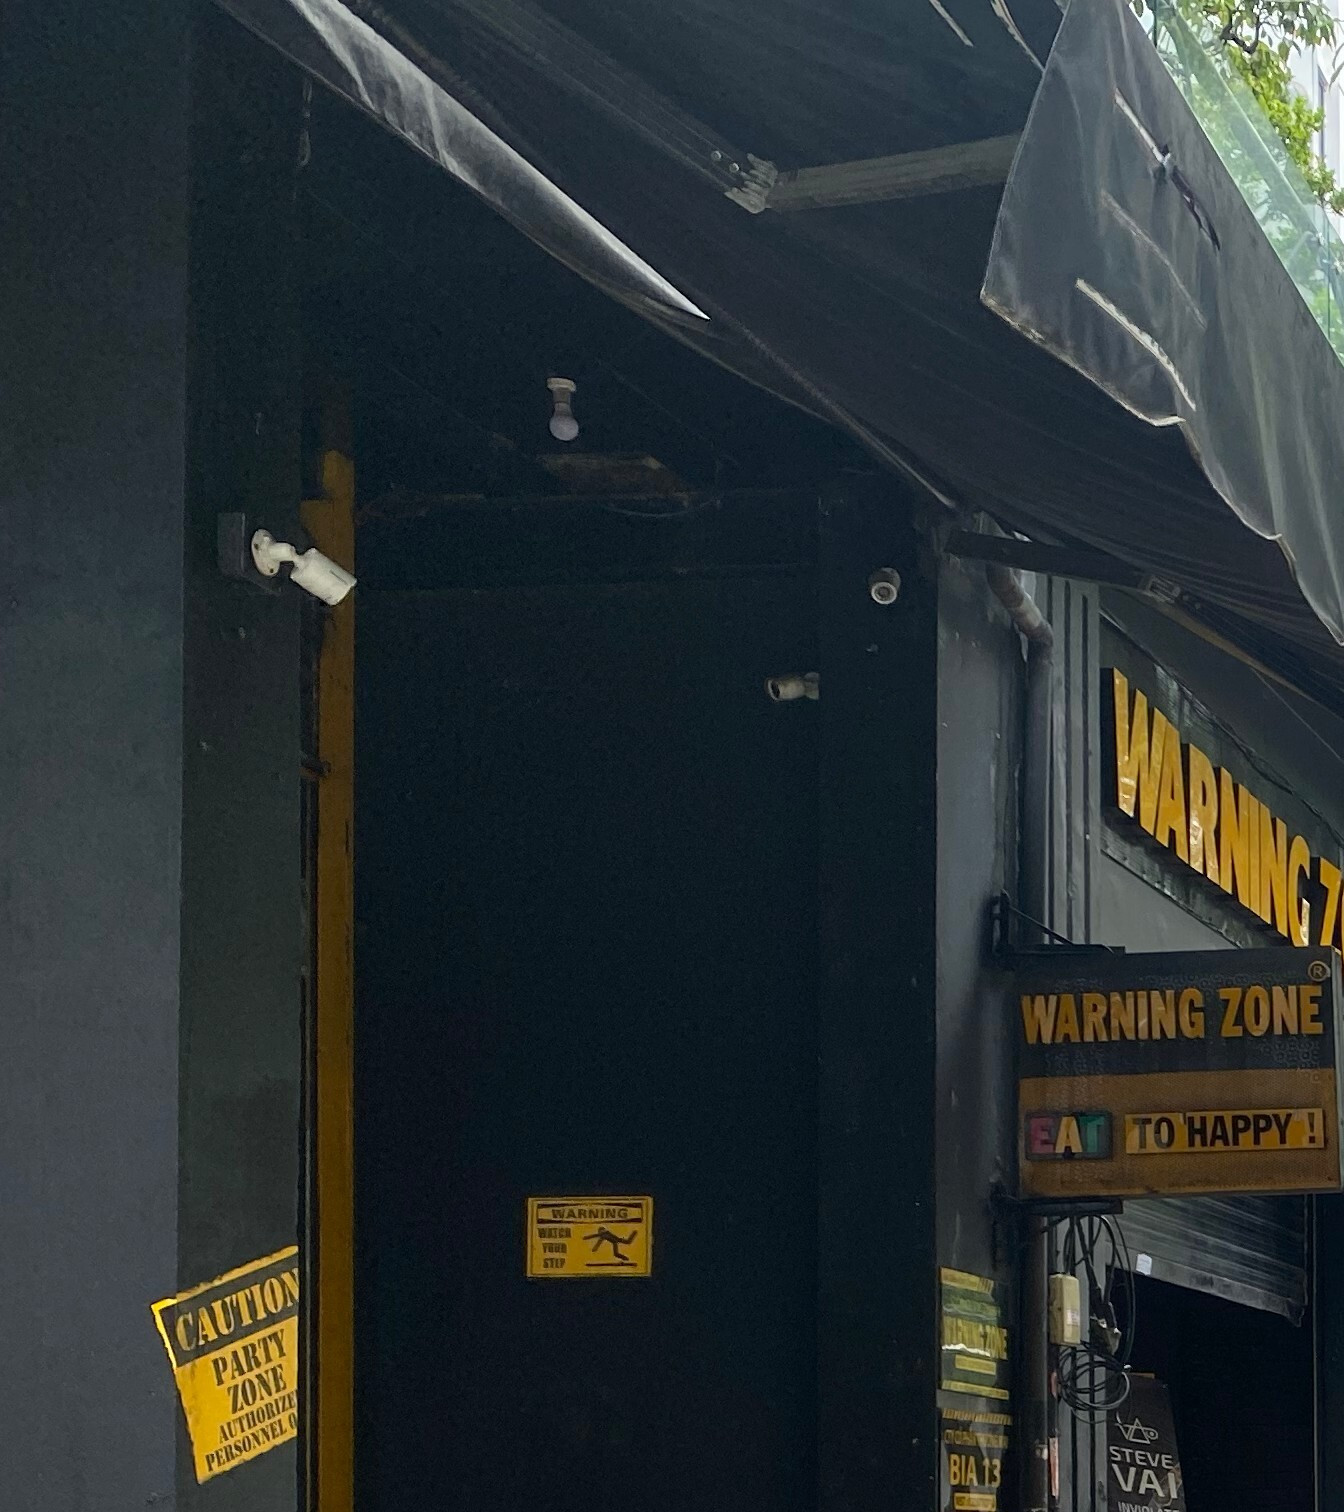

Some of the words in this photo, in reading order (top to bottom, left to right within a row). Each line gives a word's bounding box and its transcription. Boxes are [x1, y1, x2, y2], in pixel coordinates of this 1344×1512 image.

[1113, 666, 1310, 947] WARNING
[1020, 988, 1205, 1044] WARNING
[1219, 984, 1324, 1038] ZONE
[1029, 1114, 1105, 1154] EAT
[1135, 1116, 1175, 1150] TO
[1187, 1113, 1293, 1147] HAPPY
[551, 1208, 629, 1219] WARNING
[176, 1267, 299, 1351] CAUTION
[211, 1328, 287, 1387] PARTY
[227, 1363, 287, 1415] ZONE
[218, 1389, 298, 1444] AUTHORIZE
[204, 1421, 289, 1472] PERSONNEL
[949, 1453, 979, 1487] BIA
[982, 1457, 1002, 1489] 13
[1109, 1445, 1173, 1470] STEVE
[1111, 1463, 1178, 1499] VAI
